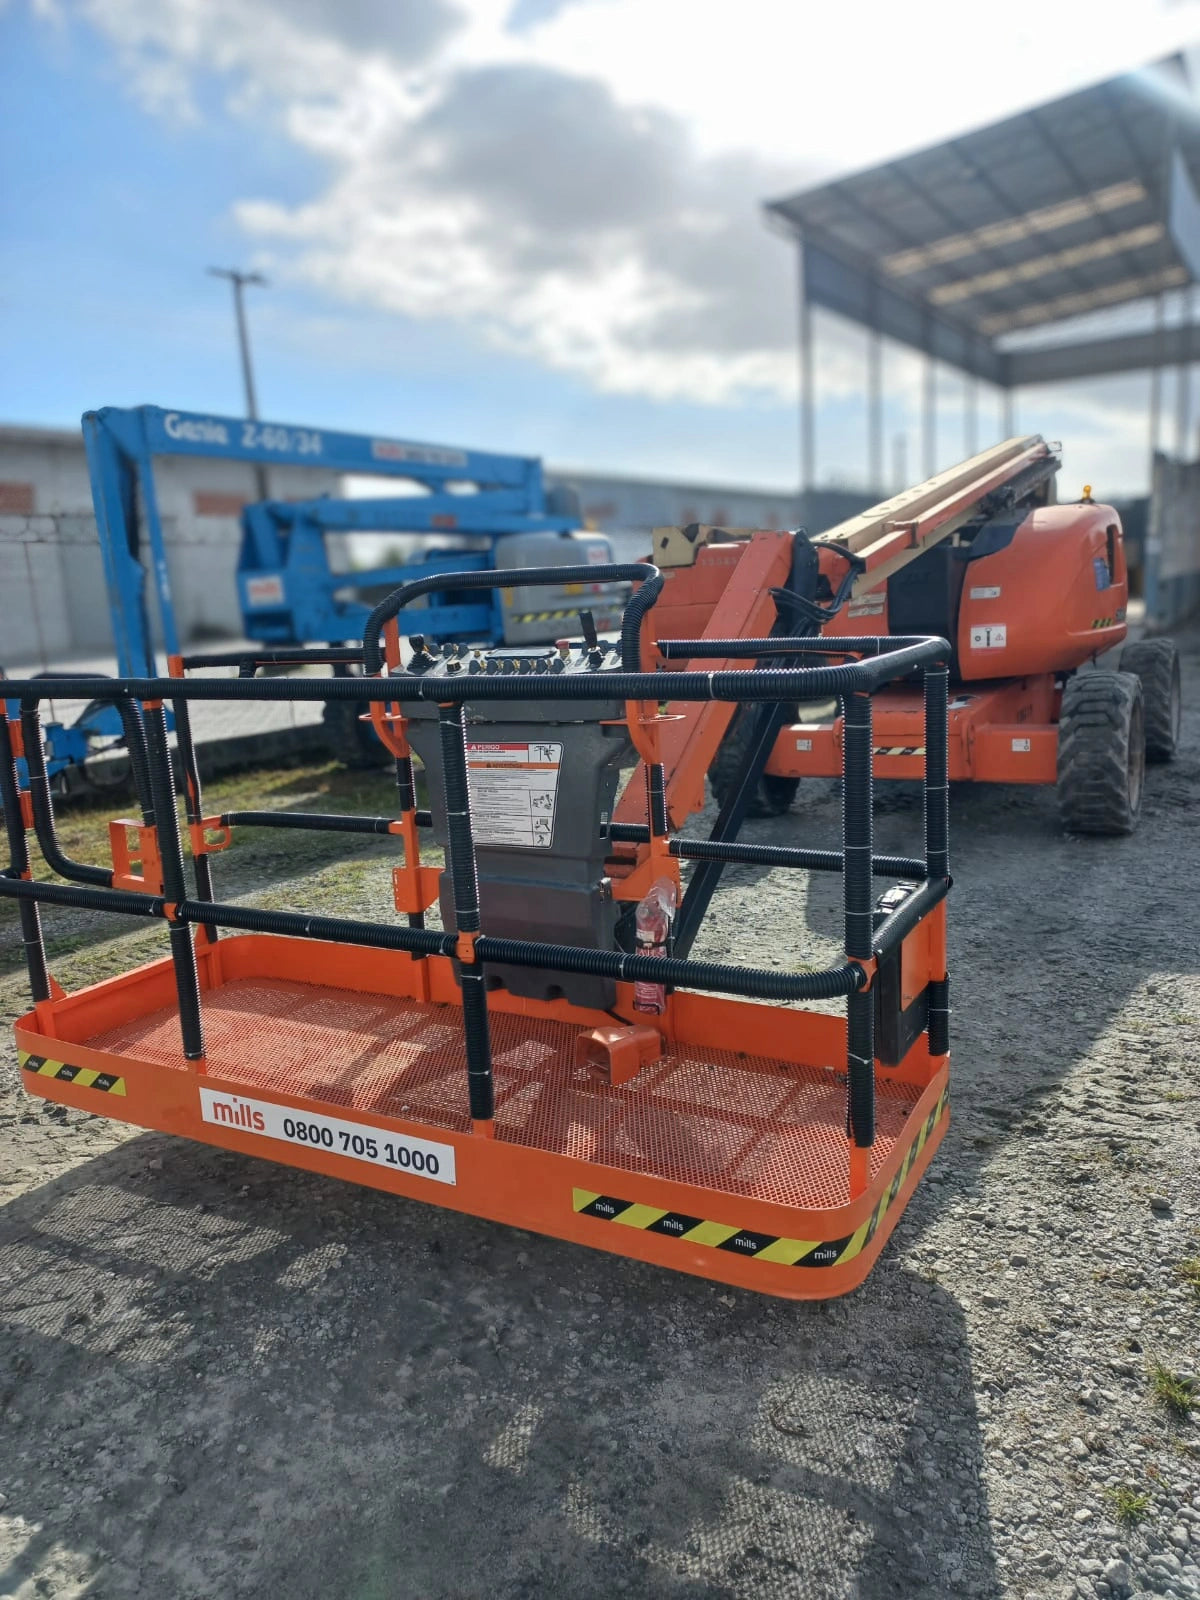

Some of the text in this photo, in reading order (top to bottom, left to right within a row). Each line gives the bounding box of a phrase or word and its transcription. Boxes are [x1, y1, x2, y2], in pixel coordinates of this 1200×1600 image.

[163, 413, 229, 445] Genie
[212, 1097, 440, 1175] mills 0800 705 1000
[595, 1201, 615, 1214] mills
[663, 1218, 684, 1231] mills
[735, 1237, 757, 1250] mills
[814, 1248, 838, 1260] mills
